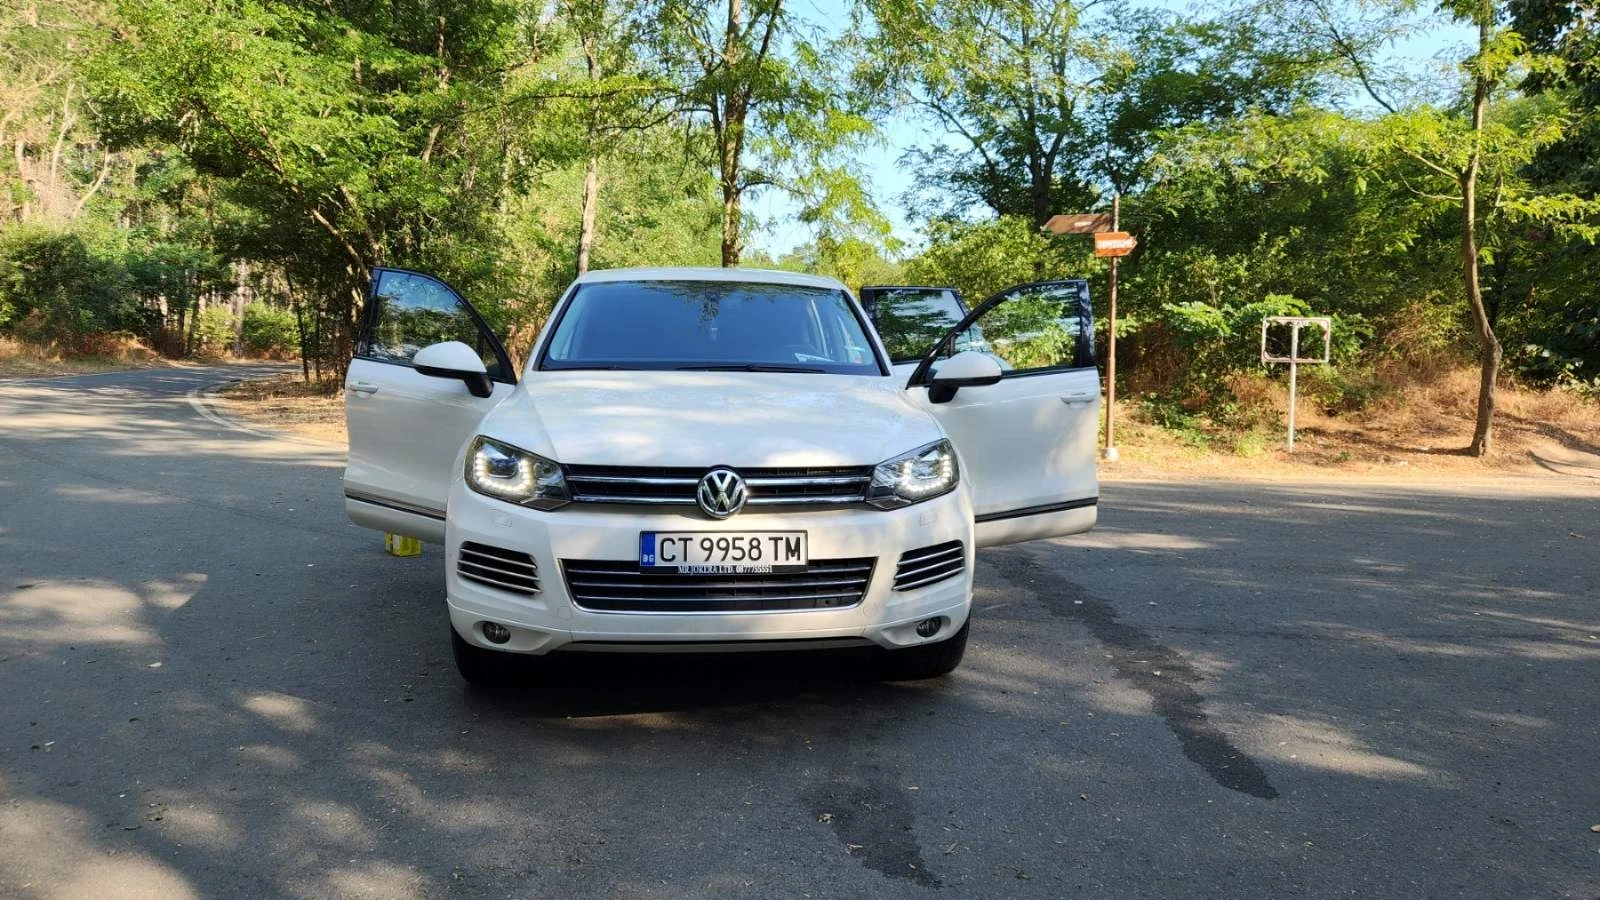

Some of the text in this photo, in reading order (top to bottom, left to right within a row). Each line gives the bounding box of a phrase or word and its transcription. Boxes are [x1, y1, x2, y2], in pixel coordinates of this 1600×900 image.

[660, 537, 801, 562] CT 9958 TM
[642, 554, 654, 562] BG
